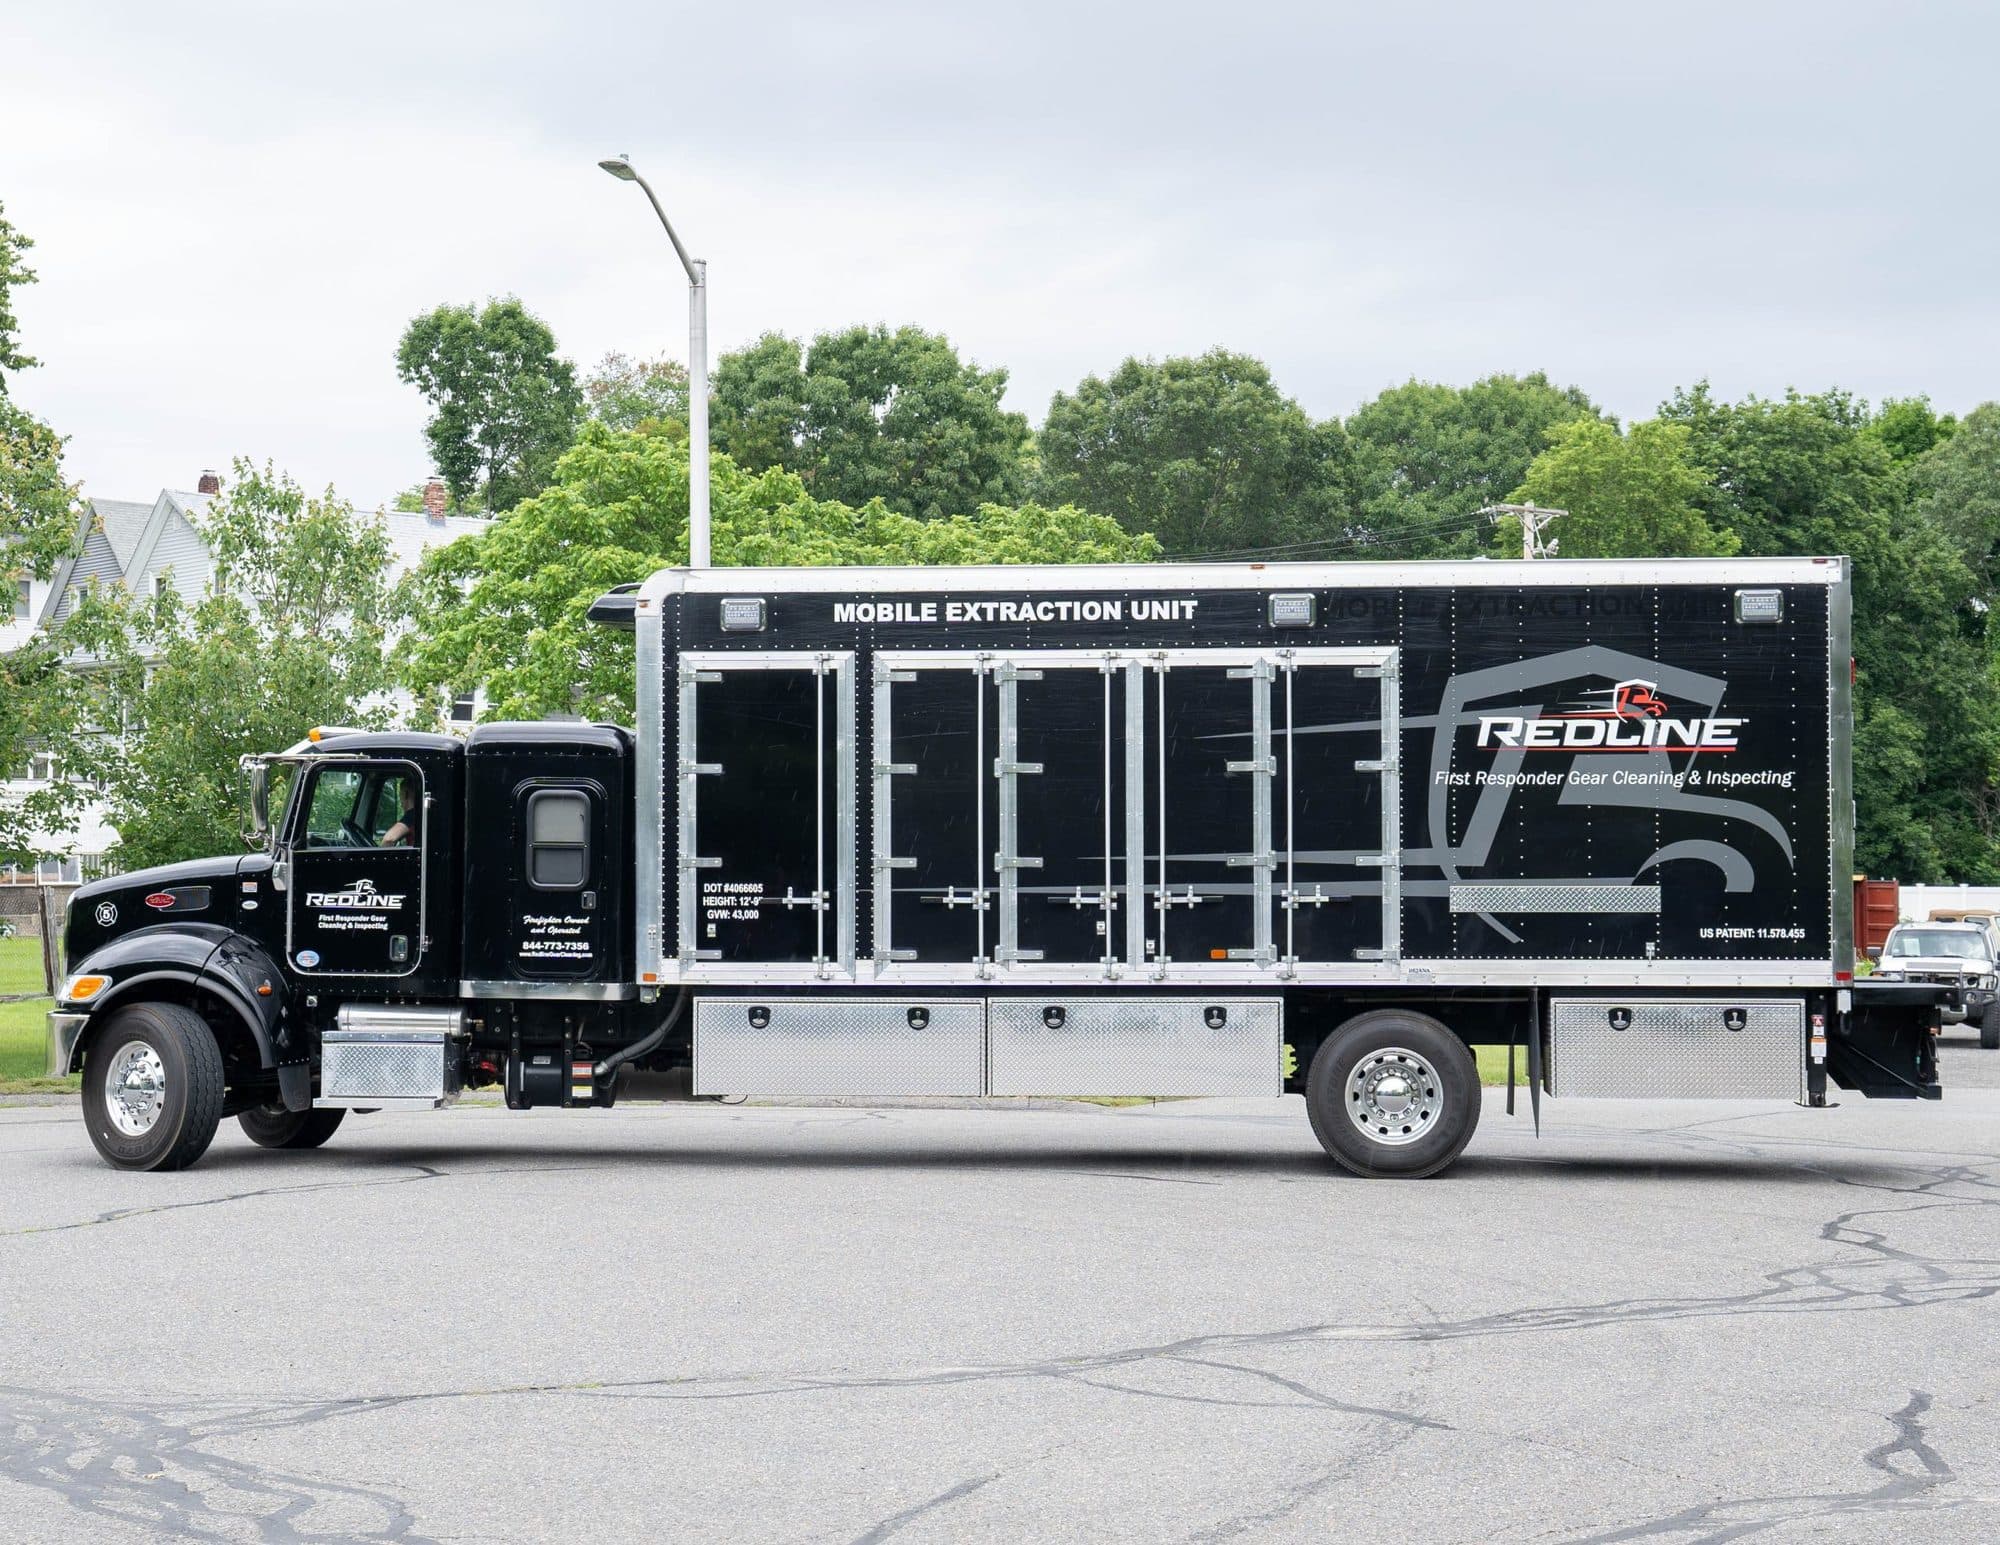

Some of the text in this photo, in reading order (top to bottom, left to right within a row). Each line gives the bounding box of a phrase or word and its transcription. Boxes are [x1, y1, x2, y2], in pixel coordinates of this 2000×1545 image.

[834, 600, 1199, 623] MOBILE EXTRACTION UNIT
[1477, 716, 1742, 747] REDLINE
[1434, 769, 1793, 789] First Responder Gear Cleaning & Inspecting
[703, 883, 722, 893] DOT
[305, 893, 407, 907] REDLINE
[702, 896, 737, 906] HEIGHT:
[319, 914, 387, 923] First Responder Gear
[707, 910, 760, 921] GVW: 43,000
[318, 921, 347, 931] Cleaning
[354, 921, 389, 931] Inspecting
[1699, 928, 1806, 939] US PATENT: 11.578.455
